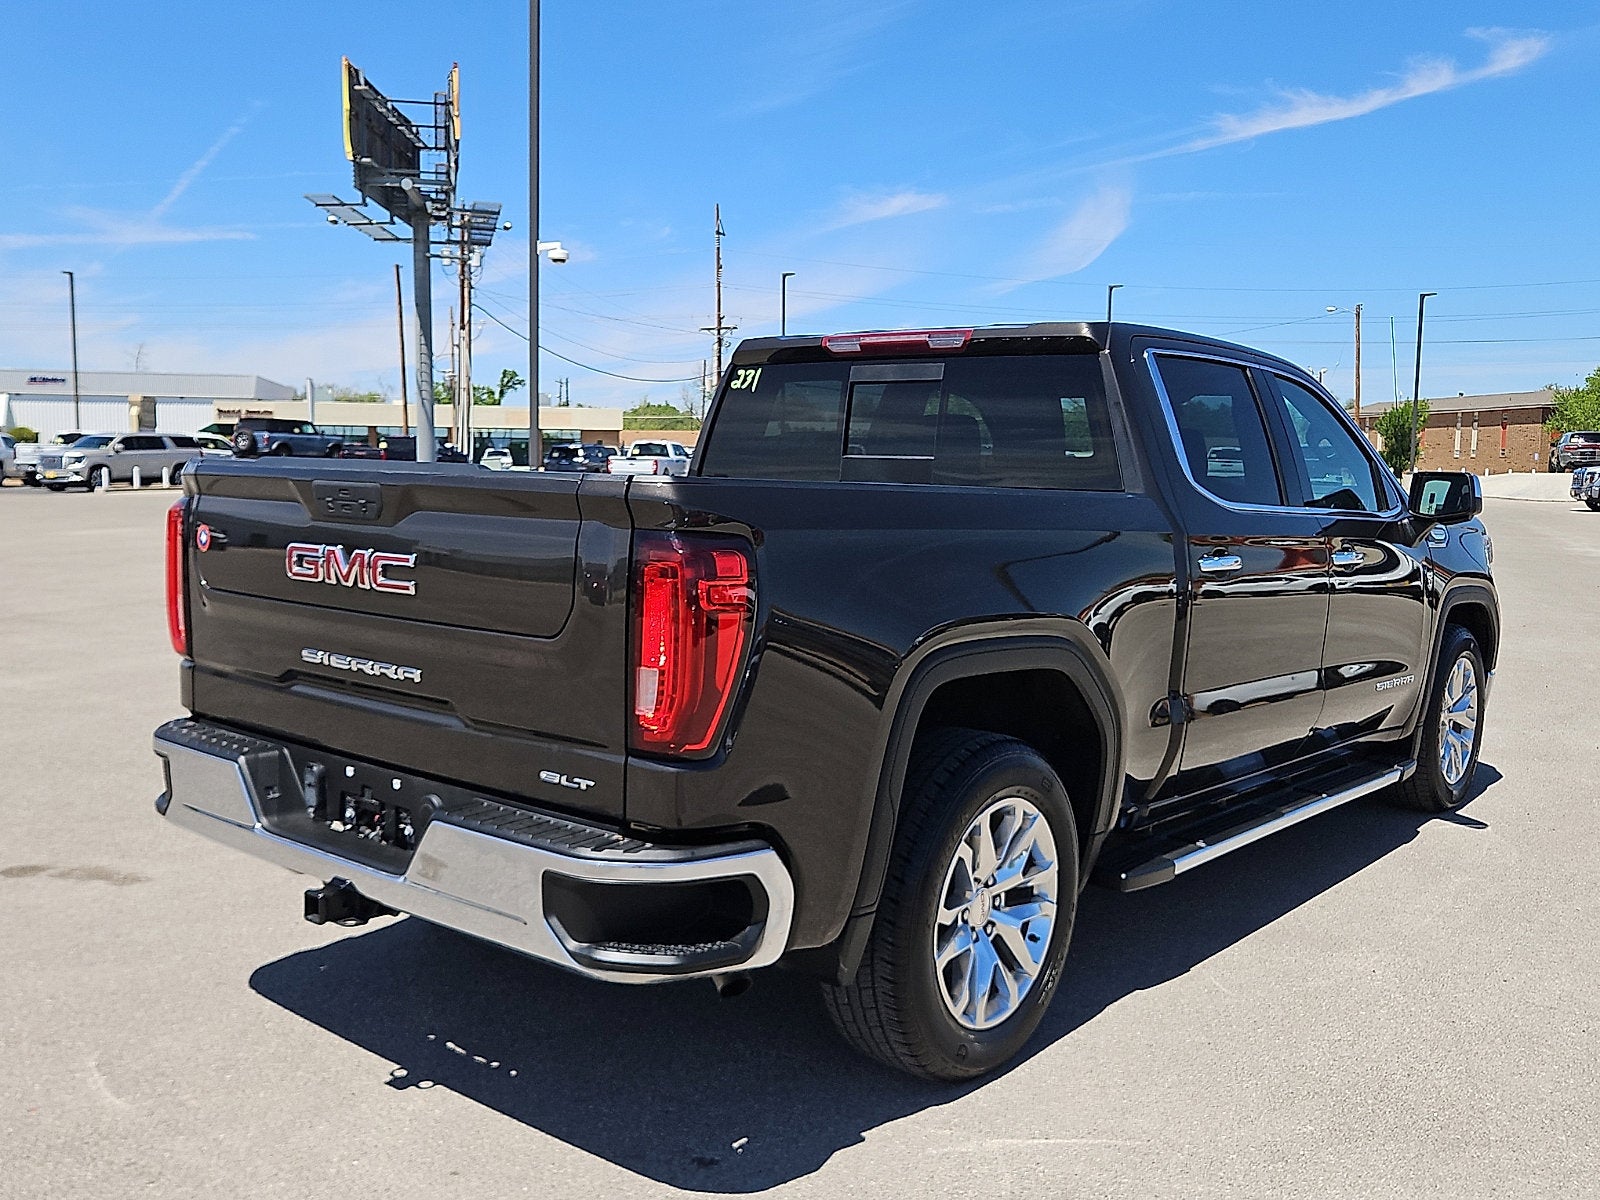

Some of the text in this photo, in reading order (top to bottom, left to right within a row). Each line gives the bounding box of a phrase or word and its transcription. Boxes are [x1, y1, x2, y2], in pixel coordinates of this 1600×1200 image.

[730, 367, 763, 393] 231
[286, 542, 418, 595] GMC
[301, 647, 423, 683] SIERRA
[1376, 674, 1415, 691] SIERRA
[539, 770, 596, 790] SLT
